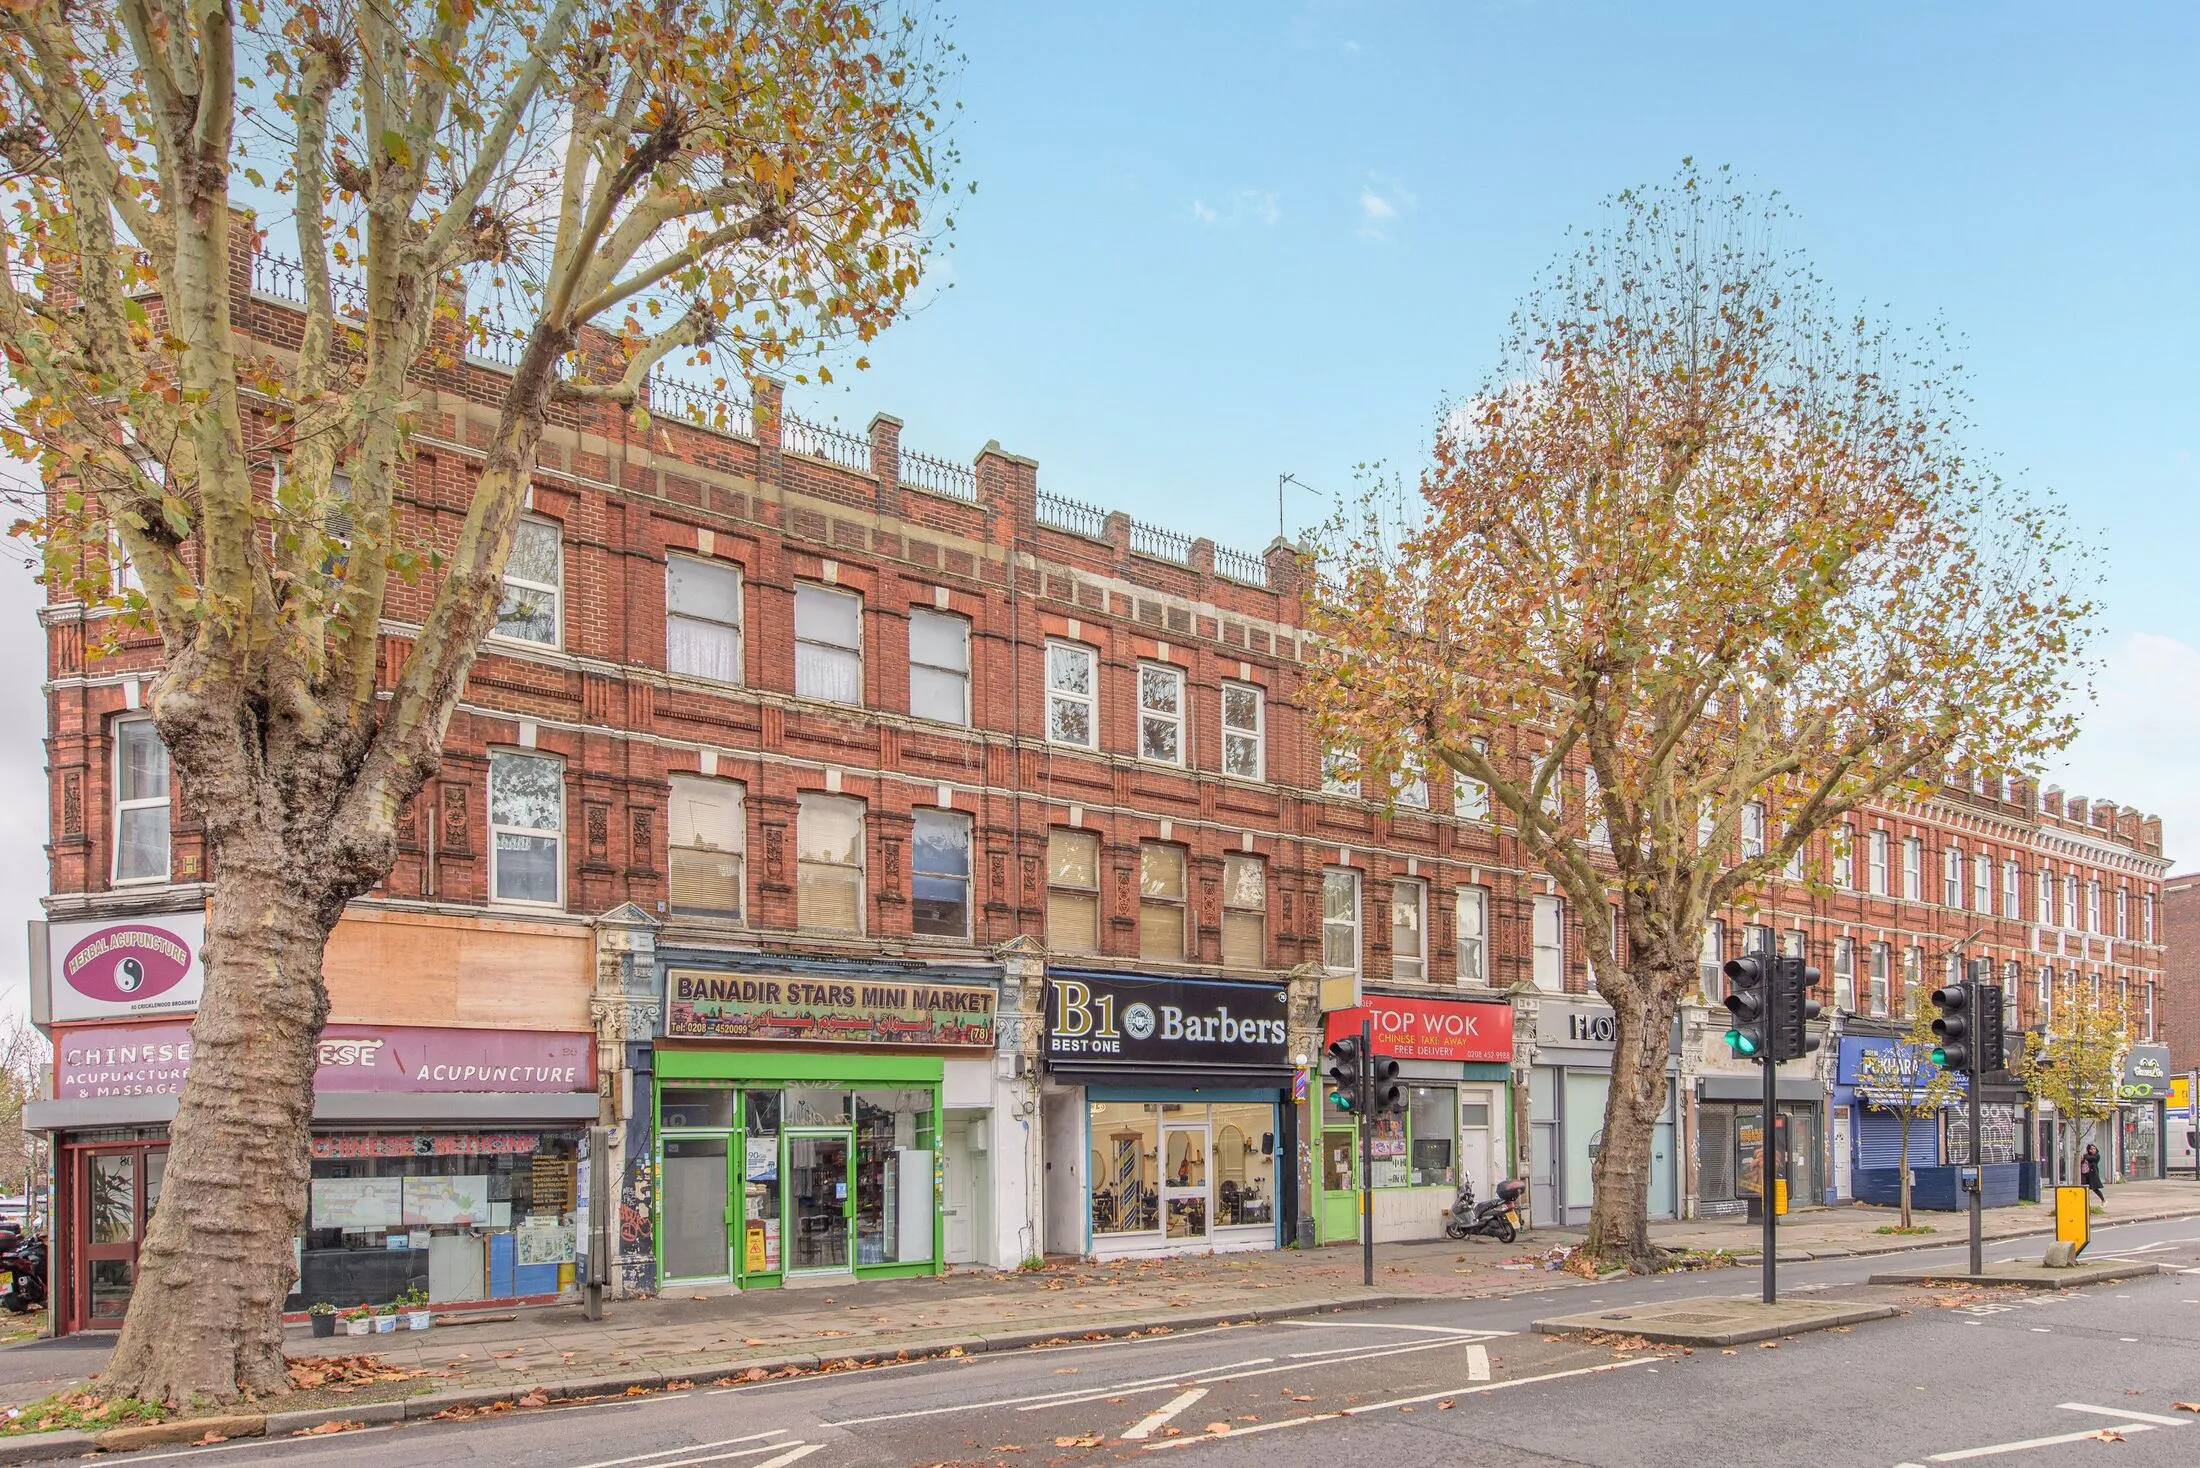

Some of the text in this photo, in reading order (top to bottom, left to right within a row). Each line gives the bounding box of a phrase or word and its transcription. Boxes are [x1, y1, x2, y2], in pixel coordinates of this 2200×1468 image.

[68, 931, 188, 976] HERBAL ACUPUNCTURE
[678, 977, 992, 1014] BANADIR STARS MINI MARKET
[137, 1002, 171, 1010] CRICKLEWOOD
[1052, 980, 1120, 1038] B1
[671, 1023, 686, 1033] Tel:
[688, 1022, 706, 1033] 0208
[715, 1023, 748, 1034] 4520099
[1160, 1006, 1286, 1044] Barbers
[1369, 1009, 1479, 1036] TOP WOK
[970, 1028, 988, 1041] (78)
[1378, 1033, 1416, 1044] CHINESE
[1444, 1037, 1467, 1046] AWAY
[1052, 1039, 1120, 1052] BEST ONE
[1394, 1044, 1454, 1056] FREE DELIVERY
[67, 1042, 190, 1067] CHINESE
[1467, 1050, 1482, 1058] 0208
[417, 1064, 576, 1083] ACUPUNCTURE
[80, 1083, 177, 1098] & MASSAGE
[312, 1136, 415, 1157] CHINESE
[435, 1134, 540, 1155] MEDICINE
[120, 1156, 133, 1167] 80
